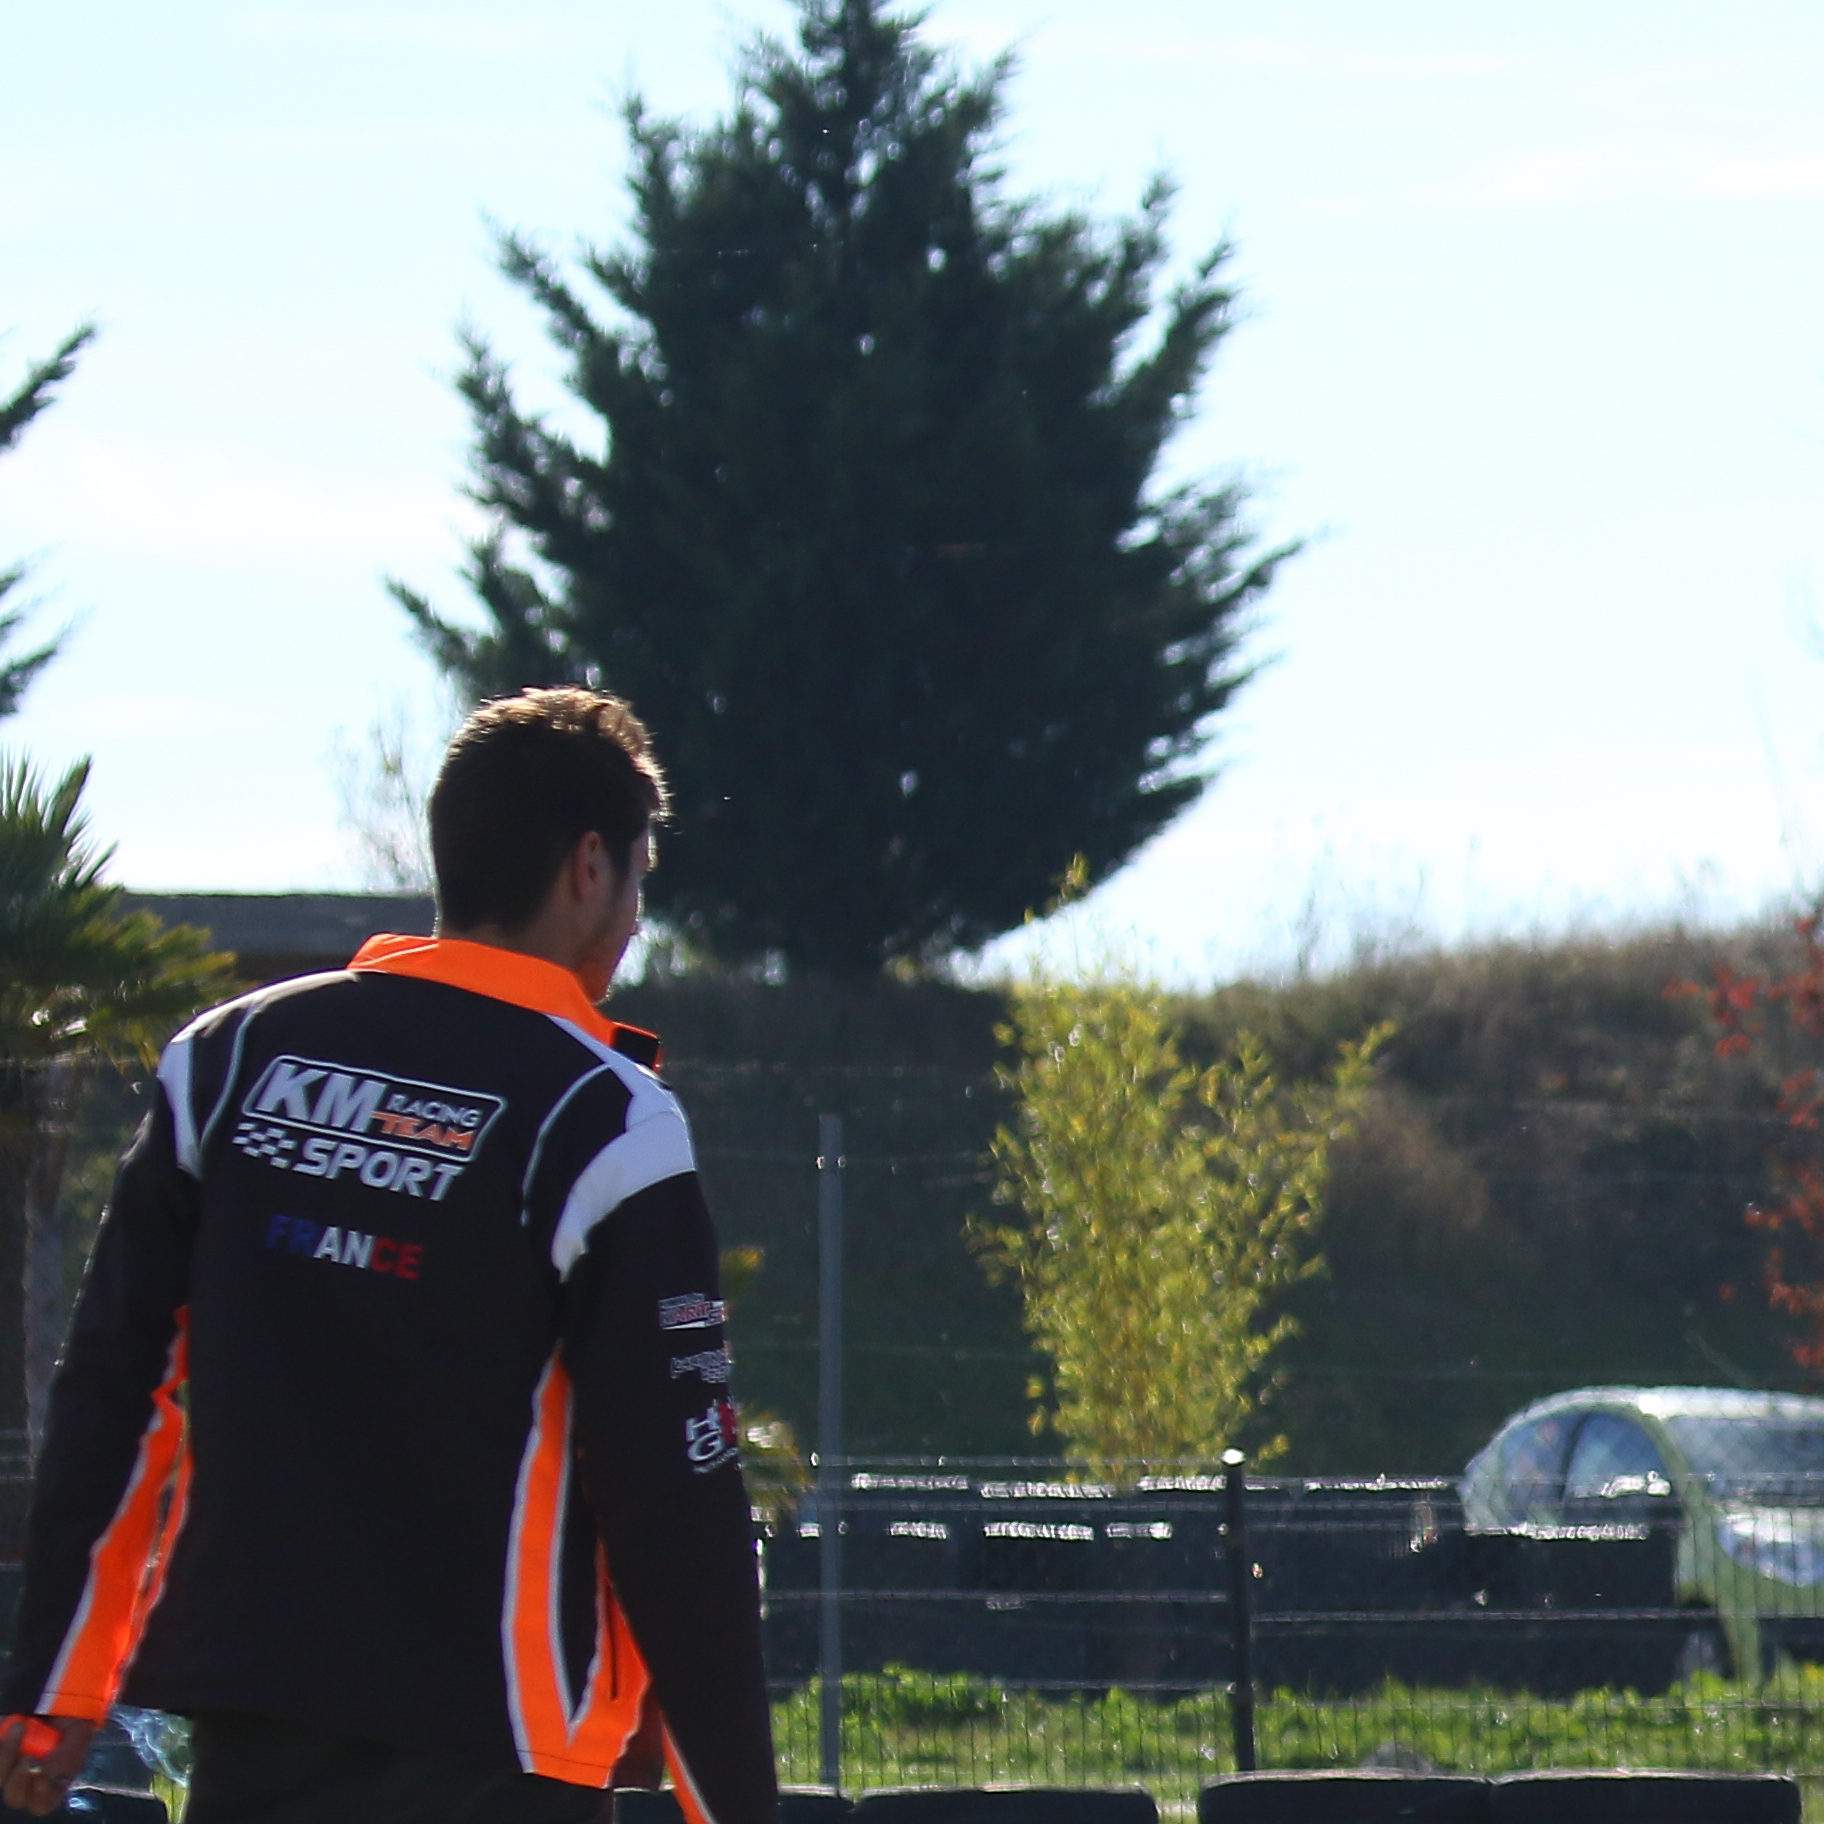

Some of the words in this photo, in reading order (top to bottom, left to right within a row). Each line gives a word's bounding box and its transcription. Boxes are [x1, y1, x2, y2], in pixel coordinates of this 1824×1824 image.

[256, 1062, 389, 1134] KM
[370, 1110, 475, 1151] TEAM
[385, 1093, 482, 1128] RACING
[291, 1137, 465, 1202] SPORT
[265, 1214, 424, 1281] FRANCE
